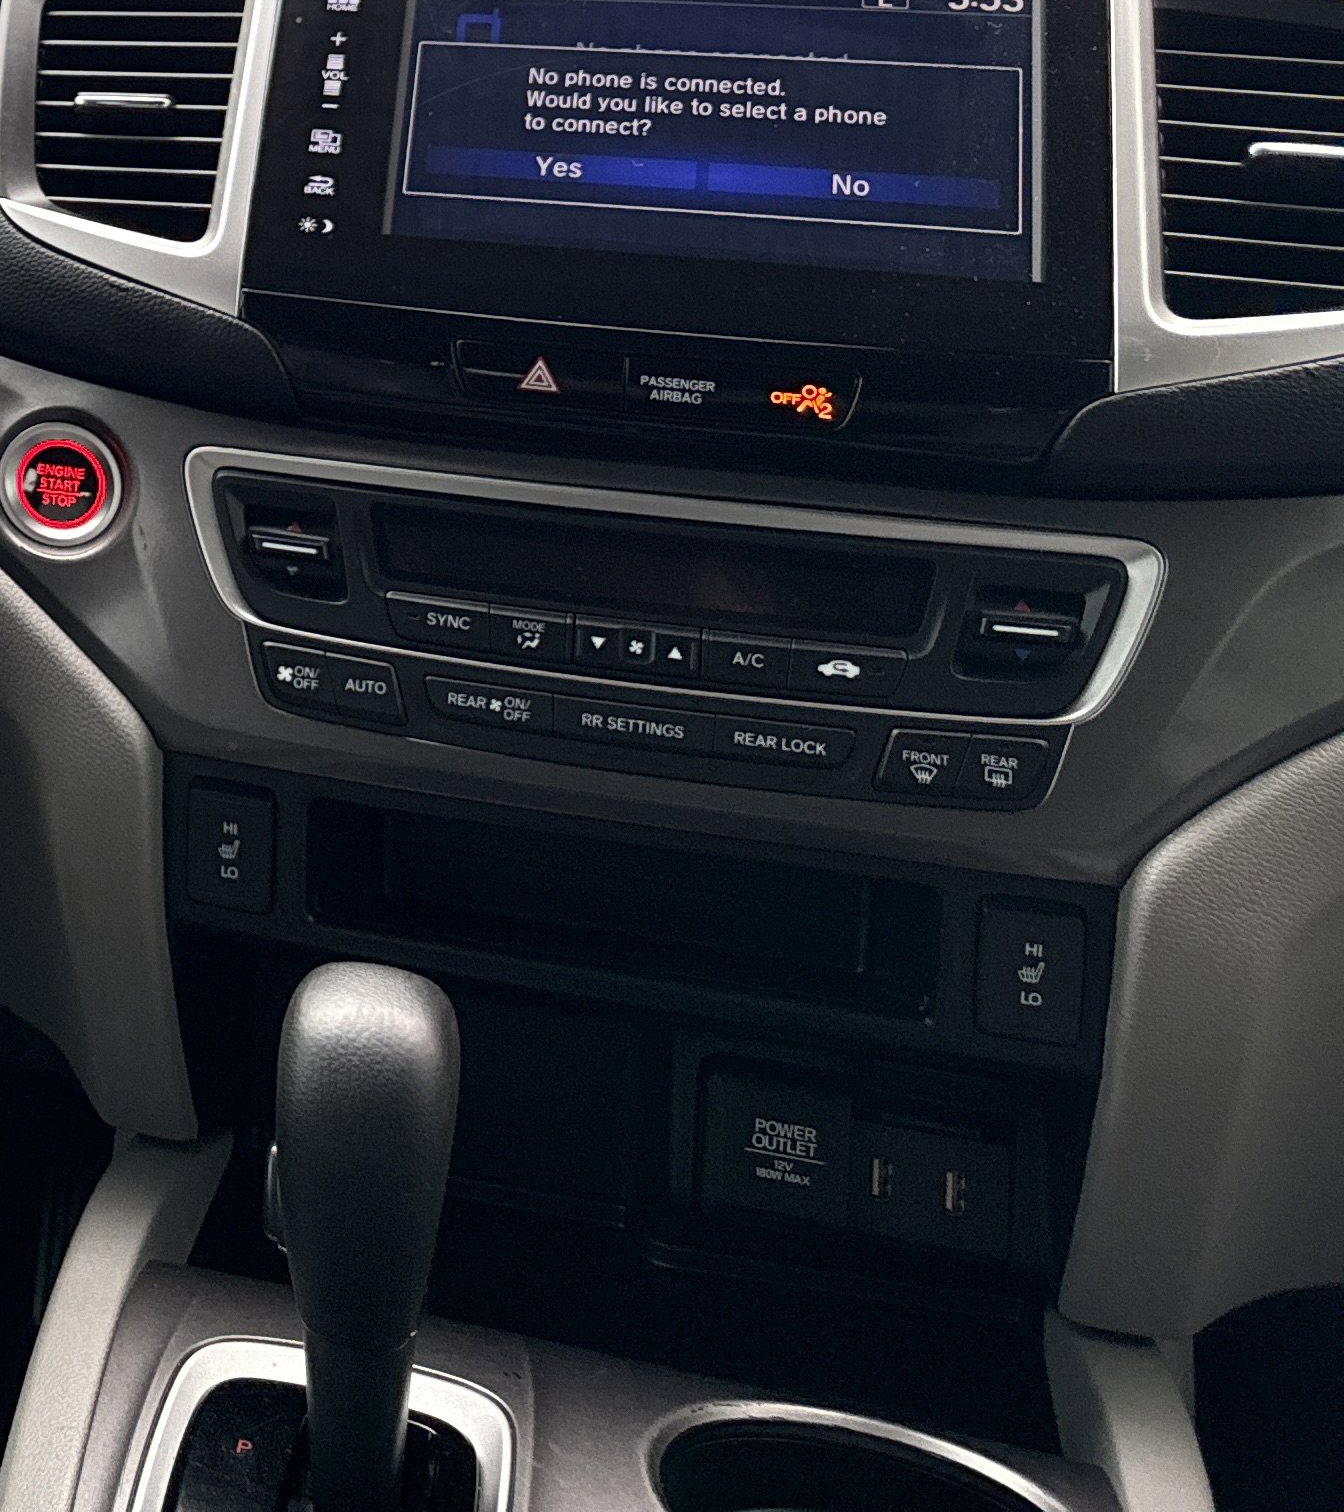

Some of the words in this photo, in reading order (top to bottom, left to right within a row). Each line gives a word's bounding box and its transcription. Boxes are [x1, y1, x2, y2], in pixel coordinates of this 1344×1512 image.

[321, 70, 349, 81] VOL
[528, 67, 559, 86] No
[564, 69, 632, 88] phone
[639, 72, 658, 90] is
[664, 76, 786, 96] connected.
[526, 90, 592, 110] Would
[597, 96, 637, 112] you
[644, 95, 684, 115] like
[690, 98, 713, 116] to
[719, 101, 788, 120] select
[793, 107, 807, 121] a
[814, 105, 887, 126] phone
[523, 113, 545, 130] to
[551, 116, 652, 136] connect?
[308, 144, 341, 155] MENU
[535, 155, 583, 178] Yes
[832, 173, 870, 196] No
[304, 185, 335, 196] BACK
[640, 374, 715, 392] PASSENGER
[649, 389, 702, 405] AIRBAG
[770, 391, 802, 405] OFF
[36, 463, 86, 480] ENGINE
[40, 477, 81, 492] START
[41, 493, 77, 507] STOP
[426, 611, 472, 630] SYNC
[512, 619, 546, 633] MODE
[732, 651, 765, 668] A/C
[294, 665, 321, 679] ON/
[293, 678, 320, 691] OFF
[344, 678, 387, 695] AUTO
[446, 692, 487, 709] REAR
[503, 695, 531, 710] ON/
[503, 709, 531, 723] OFF
[581, 712, 603, 728] RR
[607, 716, 685, 739] SETTINGS
[733, 730, 777, 750] REAR
[781, 736, 828, 756] LOCK
[901, 749, 950, 767] FRONT
[980, 753, 1018, 769] REAR
[223, 821, 239, 836] HI
[220, 864, 239, 879] LO
[1024, 942, 1043, 957] HI
[1020, 990, 1043, 1006] LO
[755, 1118, 817, 1143] POWER
[752, 1133, 818, 1158] OUTLET
[773, 1159, 794, 1172] 12V
[784, 1172, 811, 1186] MAX
[236, 1439, 253, 1454] P
